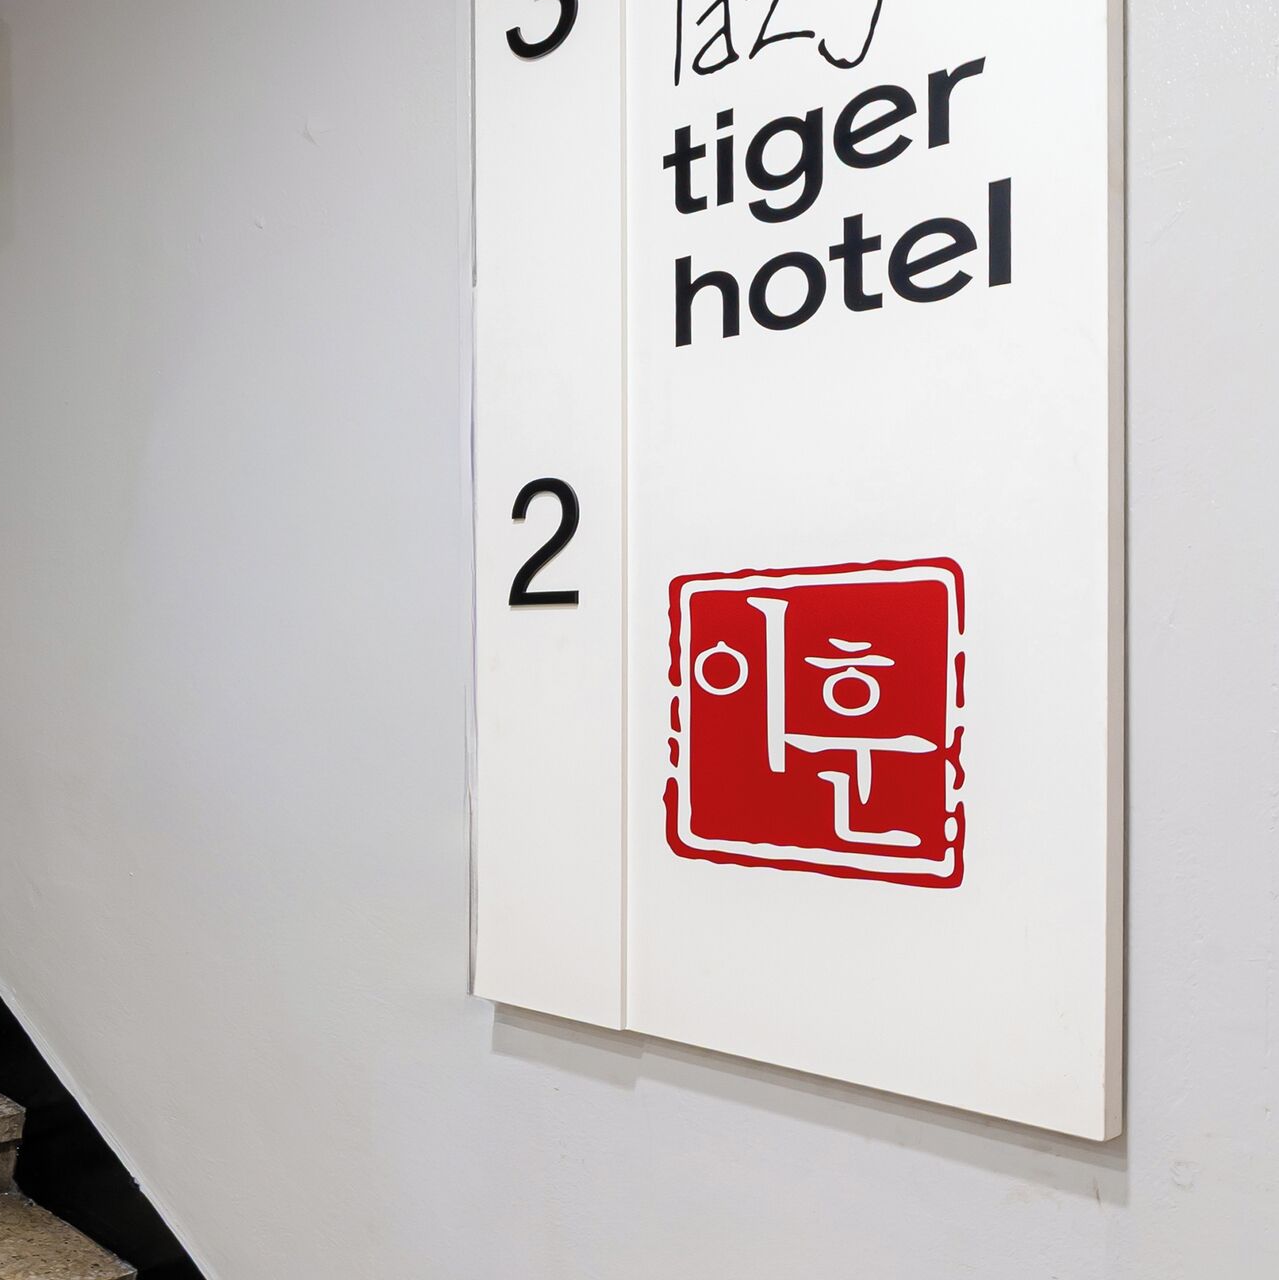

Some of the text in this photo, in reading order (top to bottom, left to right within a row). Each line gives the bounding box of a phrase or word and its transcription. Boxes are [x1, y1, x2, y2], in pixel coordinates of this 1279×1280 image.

[663, 56, 986, 224] tiger
[675, 176, 1012, 348] hotel
[508, 477, 580, 608] 2
[694, 596, 938, 847] 이훈
